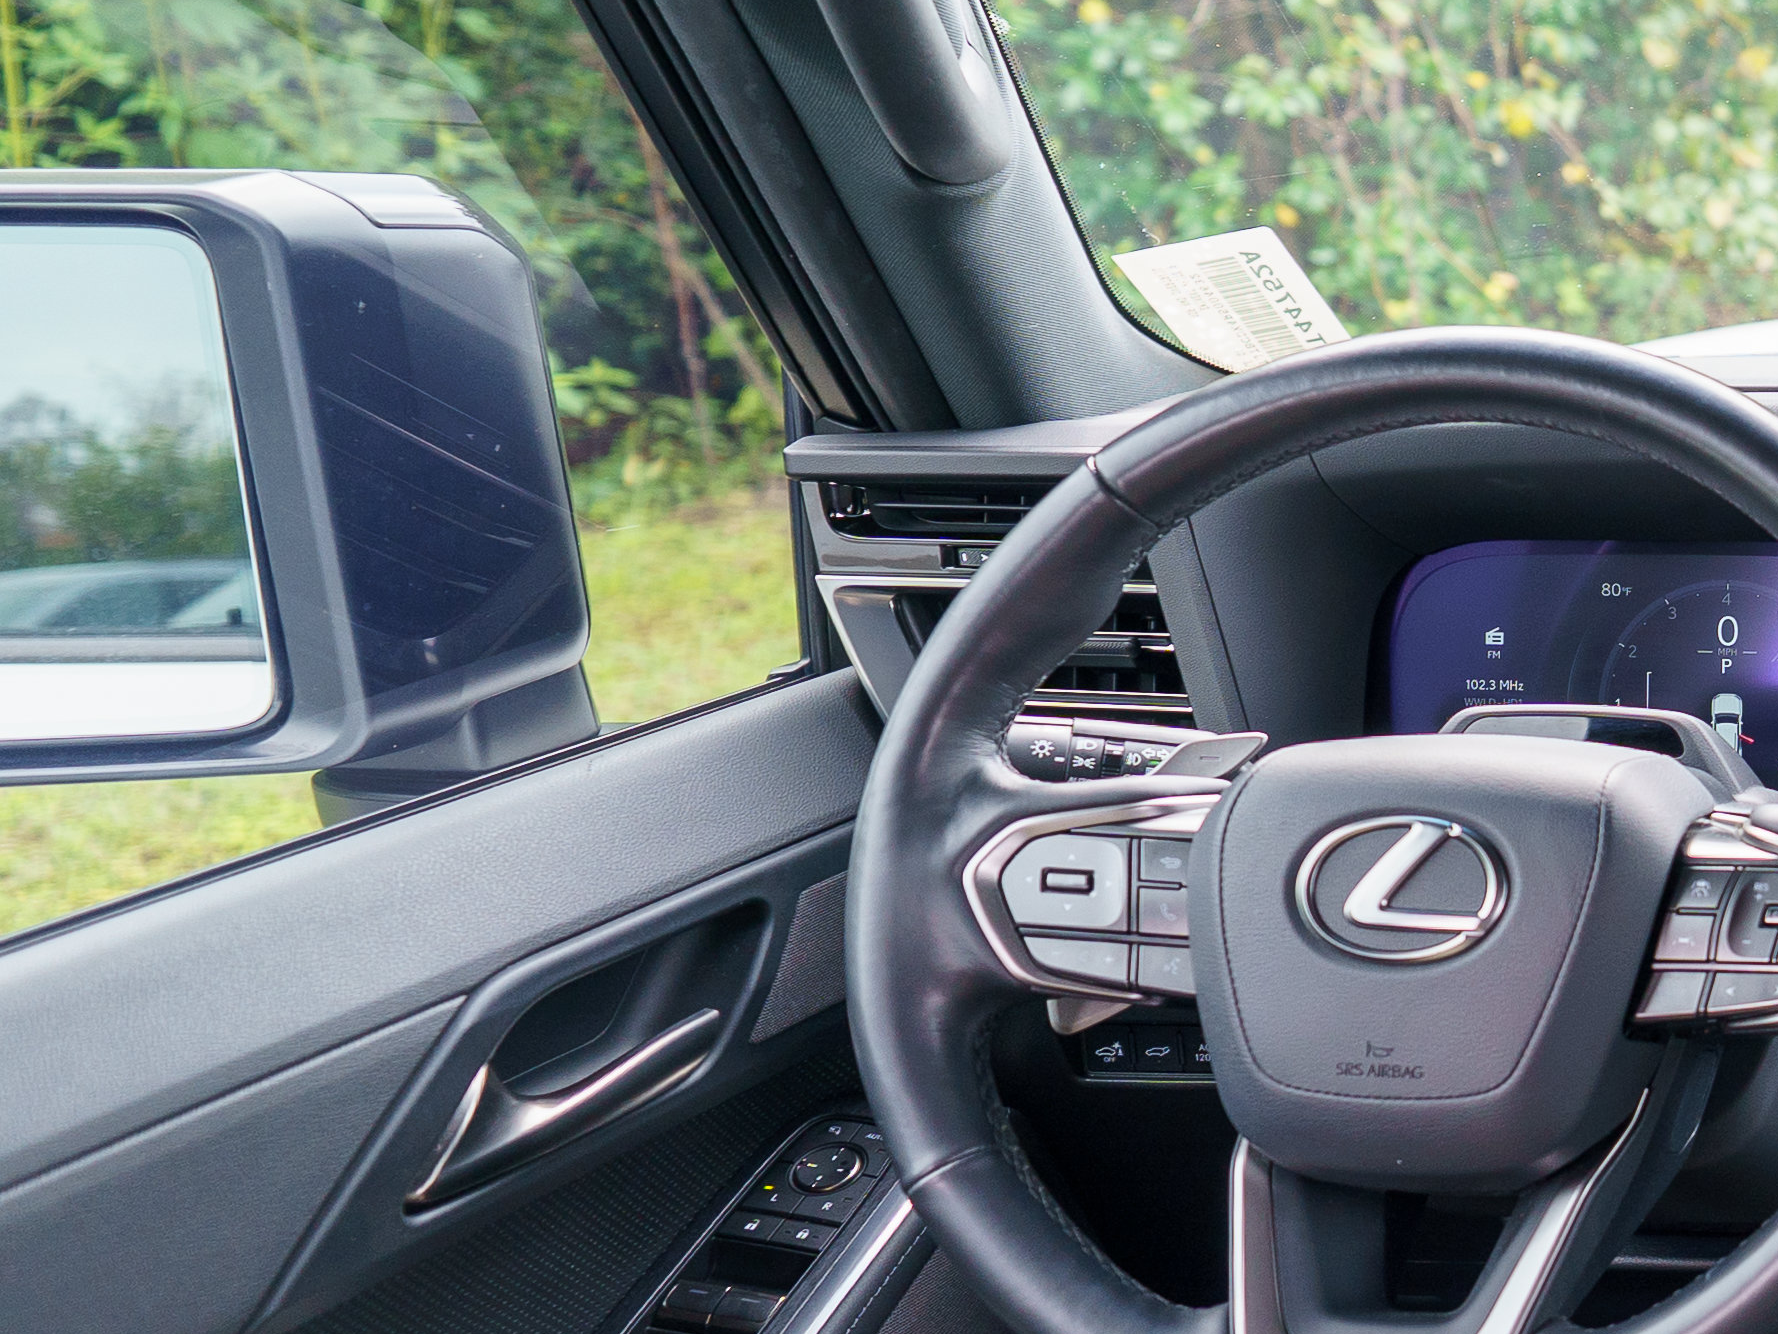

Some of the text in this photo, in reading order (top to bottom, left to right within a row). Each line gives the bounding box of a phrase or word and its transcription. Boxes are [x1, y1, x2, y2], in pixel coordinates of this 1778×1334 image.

[1722, 593, 1731, 605] 4
[1668, 607, 1677, 619] 3
[1717, 616, 1739, 646] 0
[1487, 651, 1501, 659] FM
[1628, 645, 1637, 658] 2
[1718, 648, 1737, 656] MPH
[1721, 659, 1733, 674] P
[1466, 680, 1524, 691] 102.3 MHz
[1336, 1062, 1424, 1079] SRS AIRBAG
[770, 1194, 778, 1202] L
[822, 1202, 833, 1210] R
